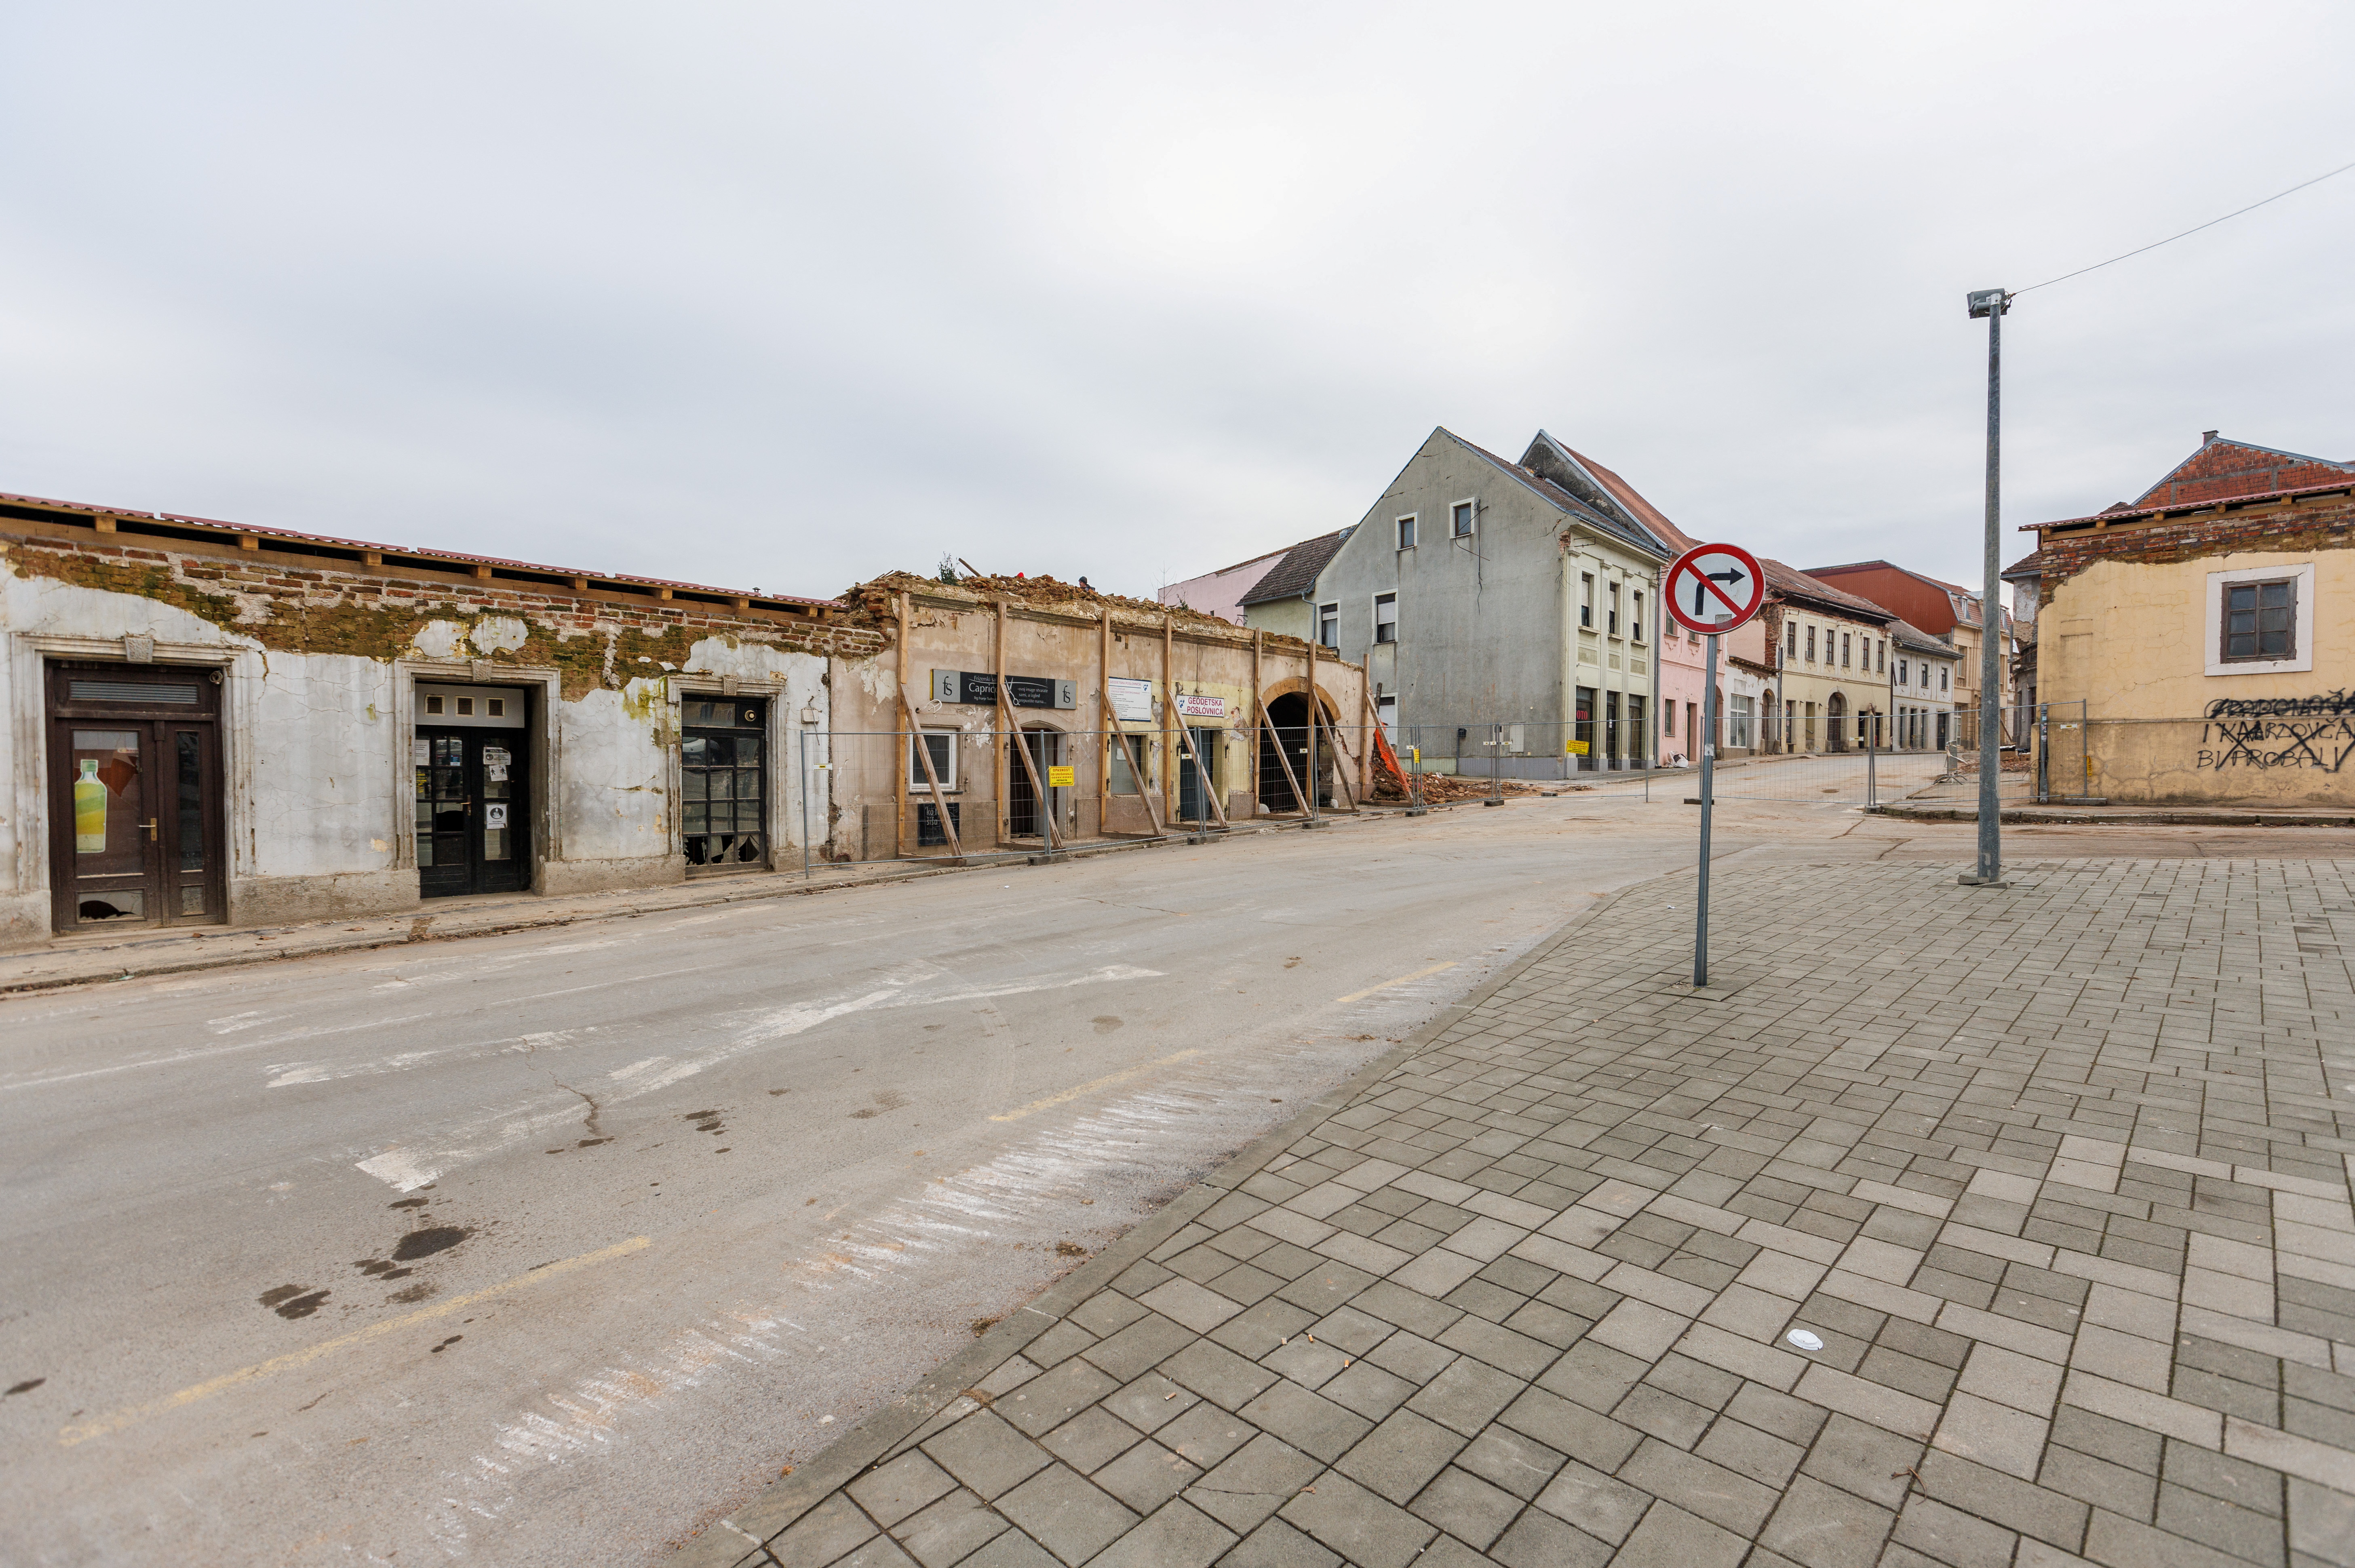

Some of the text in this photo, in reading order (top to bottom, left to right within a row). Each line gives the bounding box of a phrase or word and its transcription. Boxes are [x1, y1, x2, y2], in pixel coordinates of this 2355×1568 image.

[1188, 697, 1222, 706] GEODETSKA
[1187, 706, 1223, 715] POSLOVNICA
[1576, 710, 1588, 720] OTO
